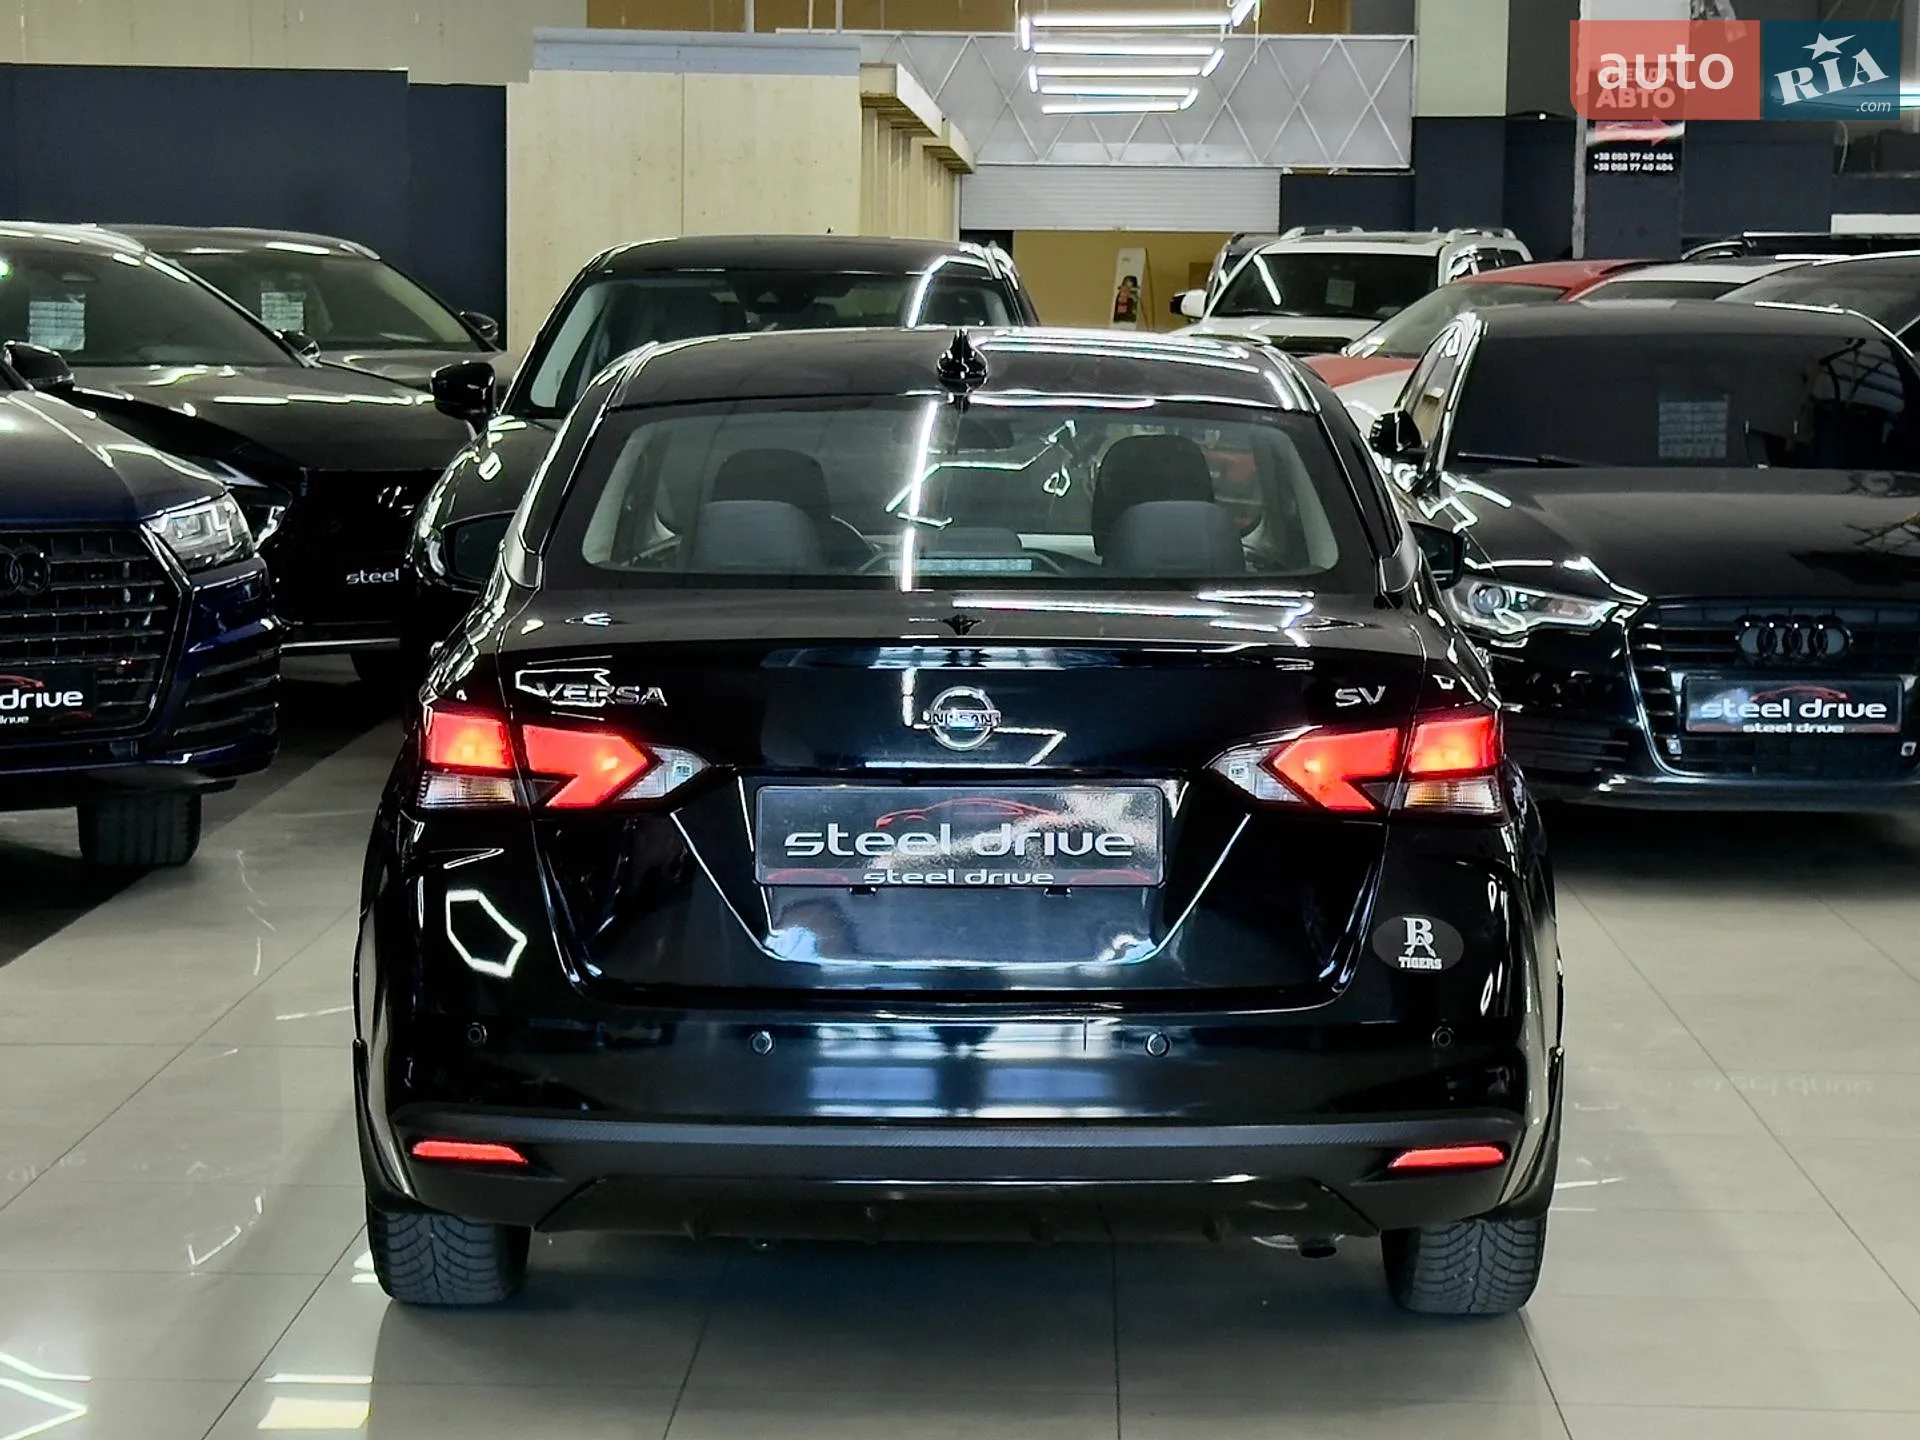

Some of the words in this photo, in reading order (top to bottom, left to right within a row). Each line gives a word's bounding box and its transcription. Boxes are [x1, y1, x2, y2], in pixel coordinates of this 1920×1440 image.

[346, 567, 399, 584] steel
[0, 688, 84, 709] drive
[535, 683, 668, 706] VERSA
[1335, 685, 1386, 707] SV
[1700, 698, 1790, 719] steel
[1799, 698, 1887, 719] drive
[1742, 723, 1792, 733] steel
[1796, 723, 1844, 733] drive
[784, 823, 951, 857] steel
[972, 823, 1135, 857] drive
[863, 868, 955, 884] steel
[964, 868, 1055, 884] drive
